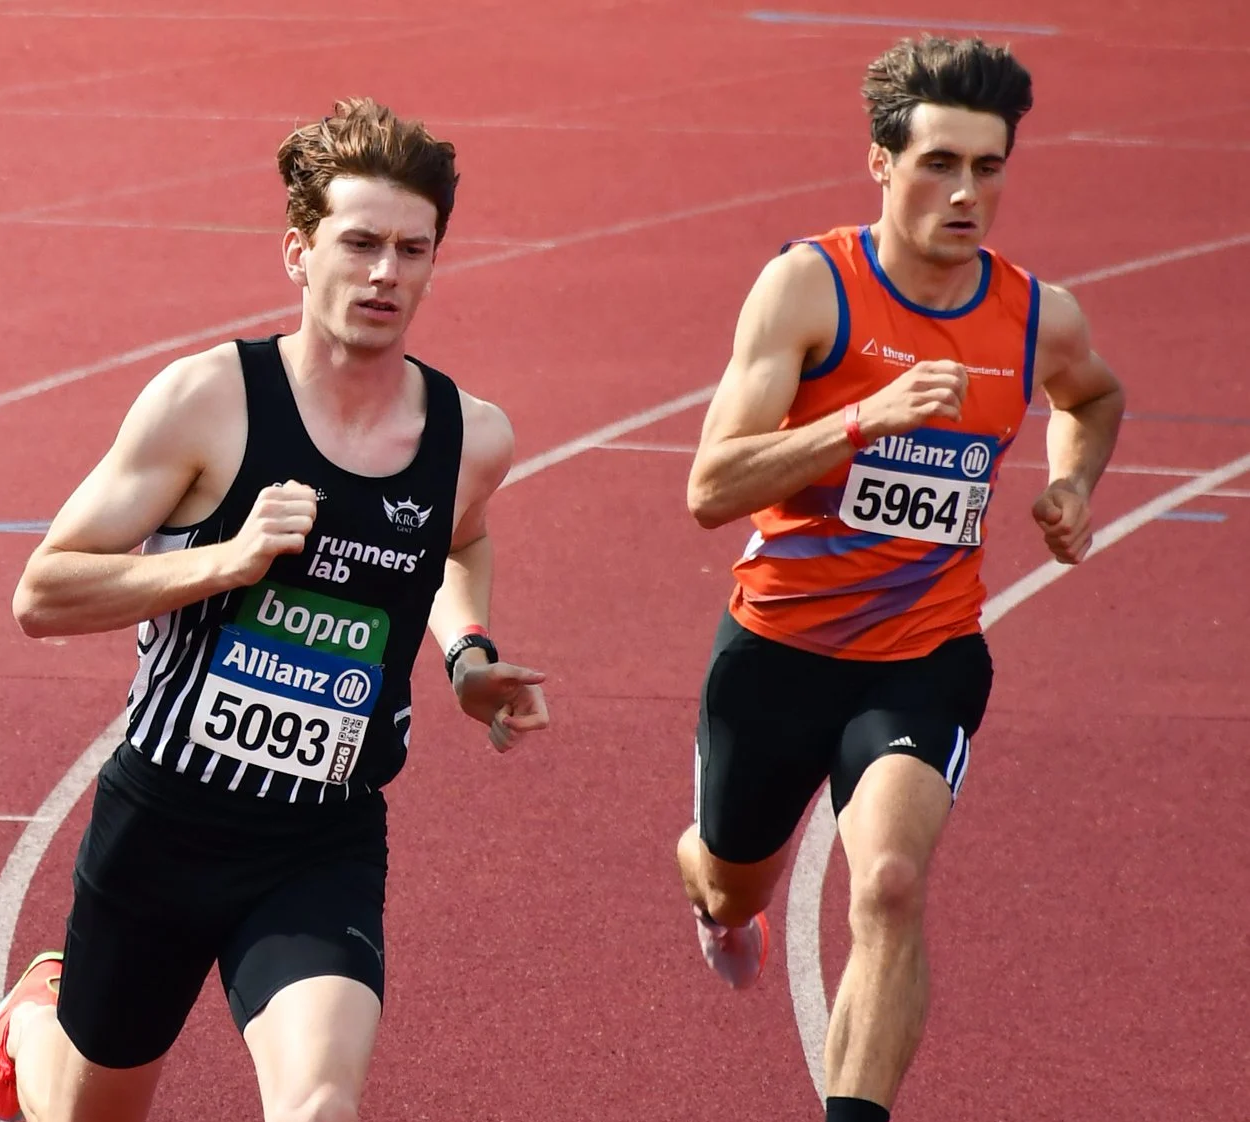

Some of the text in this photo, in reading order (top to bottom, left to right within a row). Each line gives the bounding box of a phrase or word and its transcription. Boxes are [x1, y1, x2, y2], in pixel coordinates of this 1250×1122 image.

[862, 434, 957, 469] Allianz
[395, 512, 418, 527] KRC
[853, 477, 960, 533] 5964
[961, 511, 977, 543] 2026
[307, 554, 351, 583] lab
[222, 640, 330, 695] Allianz
[204, 691, 330, 767] 5093
[331, 746, 351, 781] 2026
